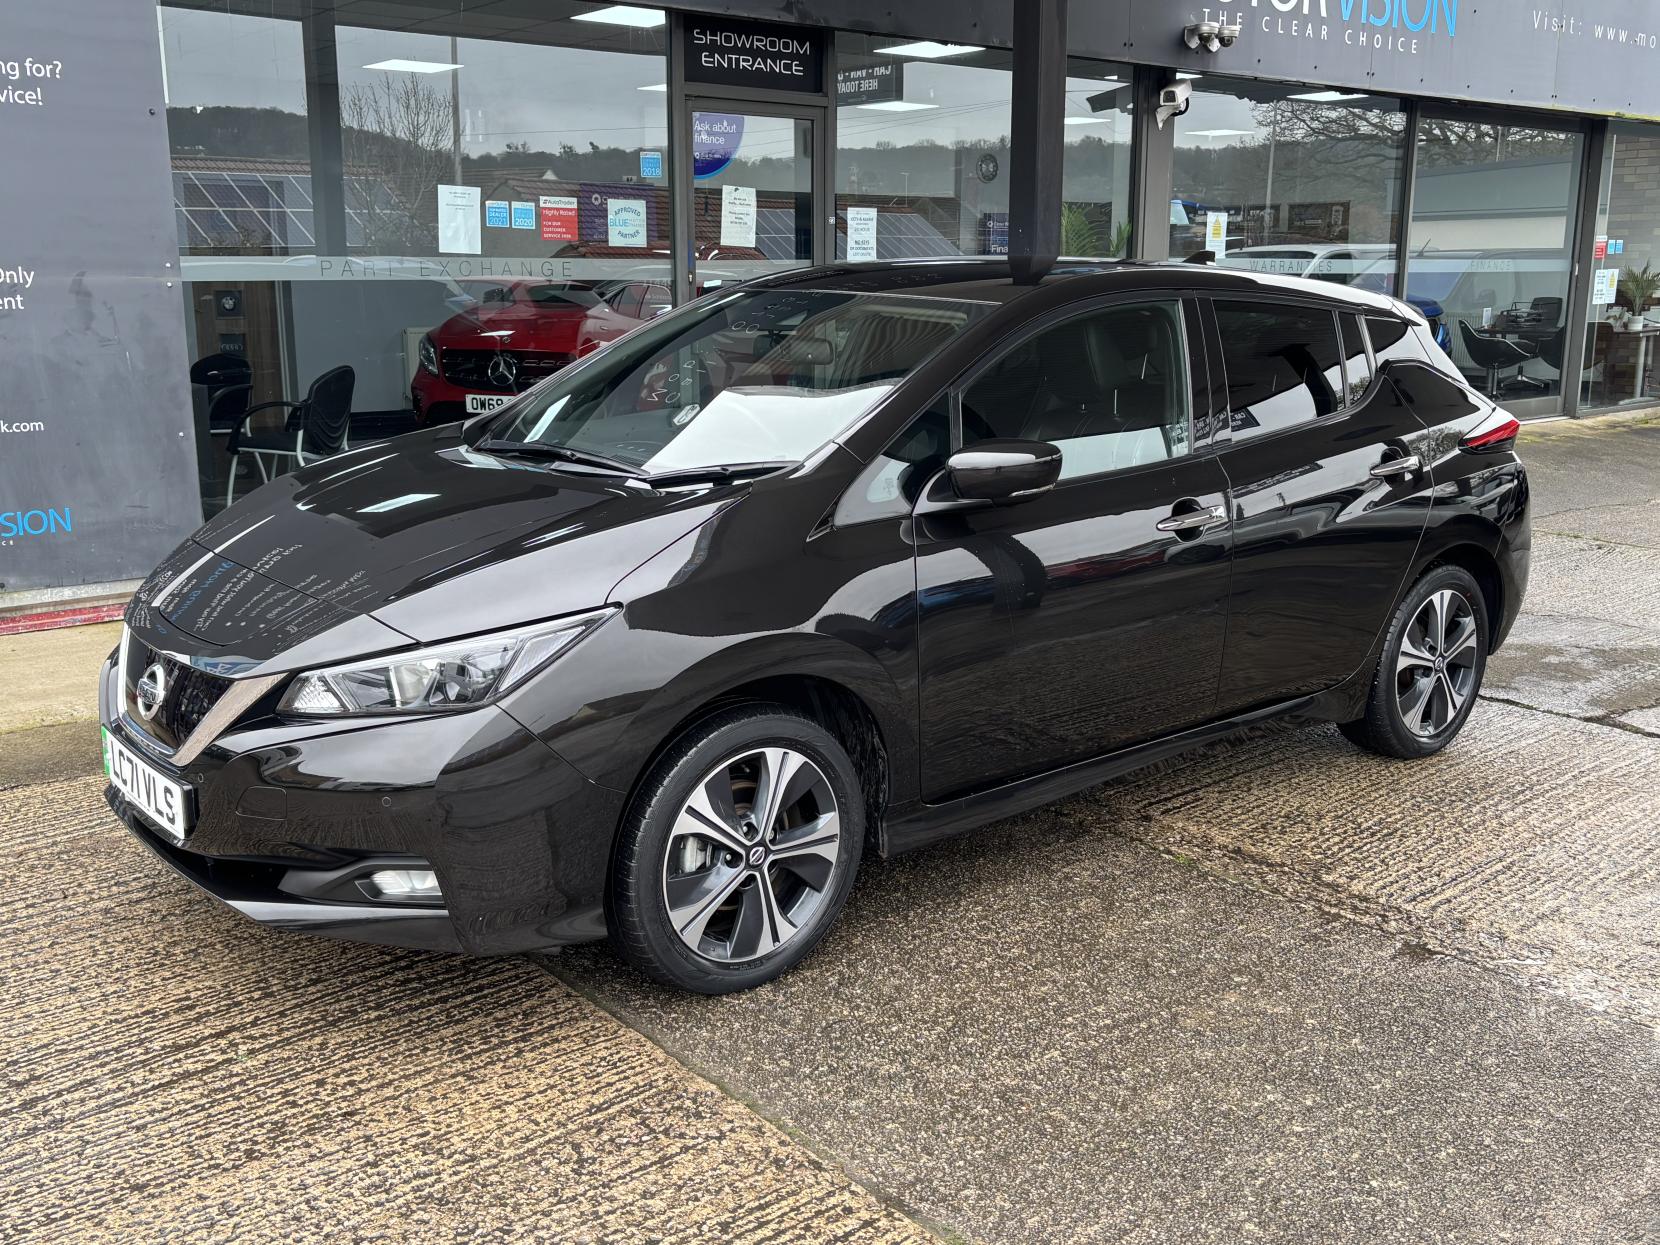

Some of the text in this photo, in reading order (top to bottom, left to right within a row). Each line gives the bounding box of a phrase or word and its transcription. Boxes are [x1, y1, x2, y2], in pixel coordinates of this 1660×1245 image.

[1202, 8, 1243, 28] THE
[1262, 16, 1328, 40] CLEAR
[1345, 29, 1418, 54] CHOICE
[1533, 9, 1657, 49] Visit: www.mo
[693, 29, 810, 55] SHOWROOM
[24, 57, 62, 79] for?
[701, 52, 804, 76] ENTRANCE
[694, 120, 737, 133] Ask about
[695, 132, 725, 145] finance
[643, 167, 661, 176] 2018
[614, 206, 641, 217] APPROVED
[515, 218, 533, 227] 2020
[609, 217, 629, 228] BLUE
[617, 229, 641, 240] PARTNER
[320, 260, 573, 277] PART EXCHANGE
[0, 266, 35, 288] nly
[0, 294, 25, 310] nt
[0, 420, 45, 433] k.com
